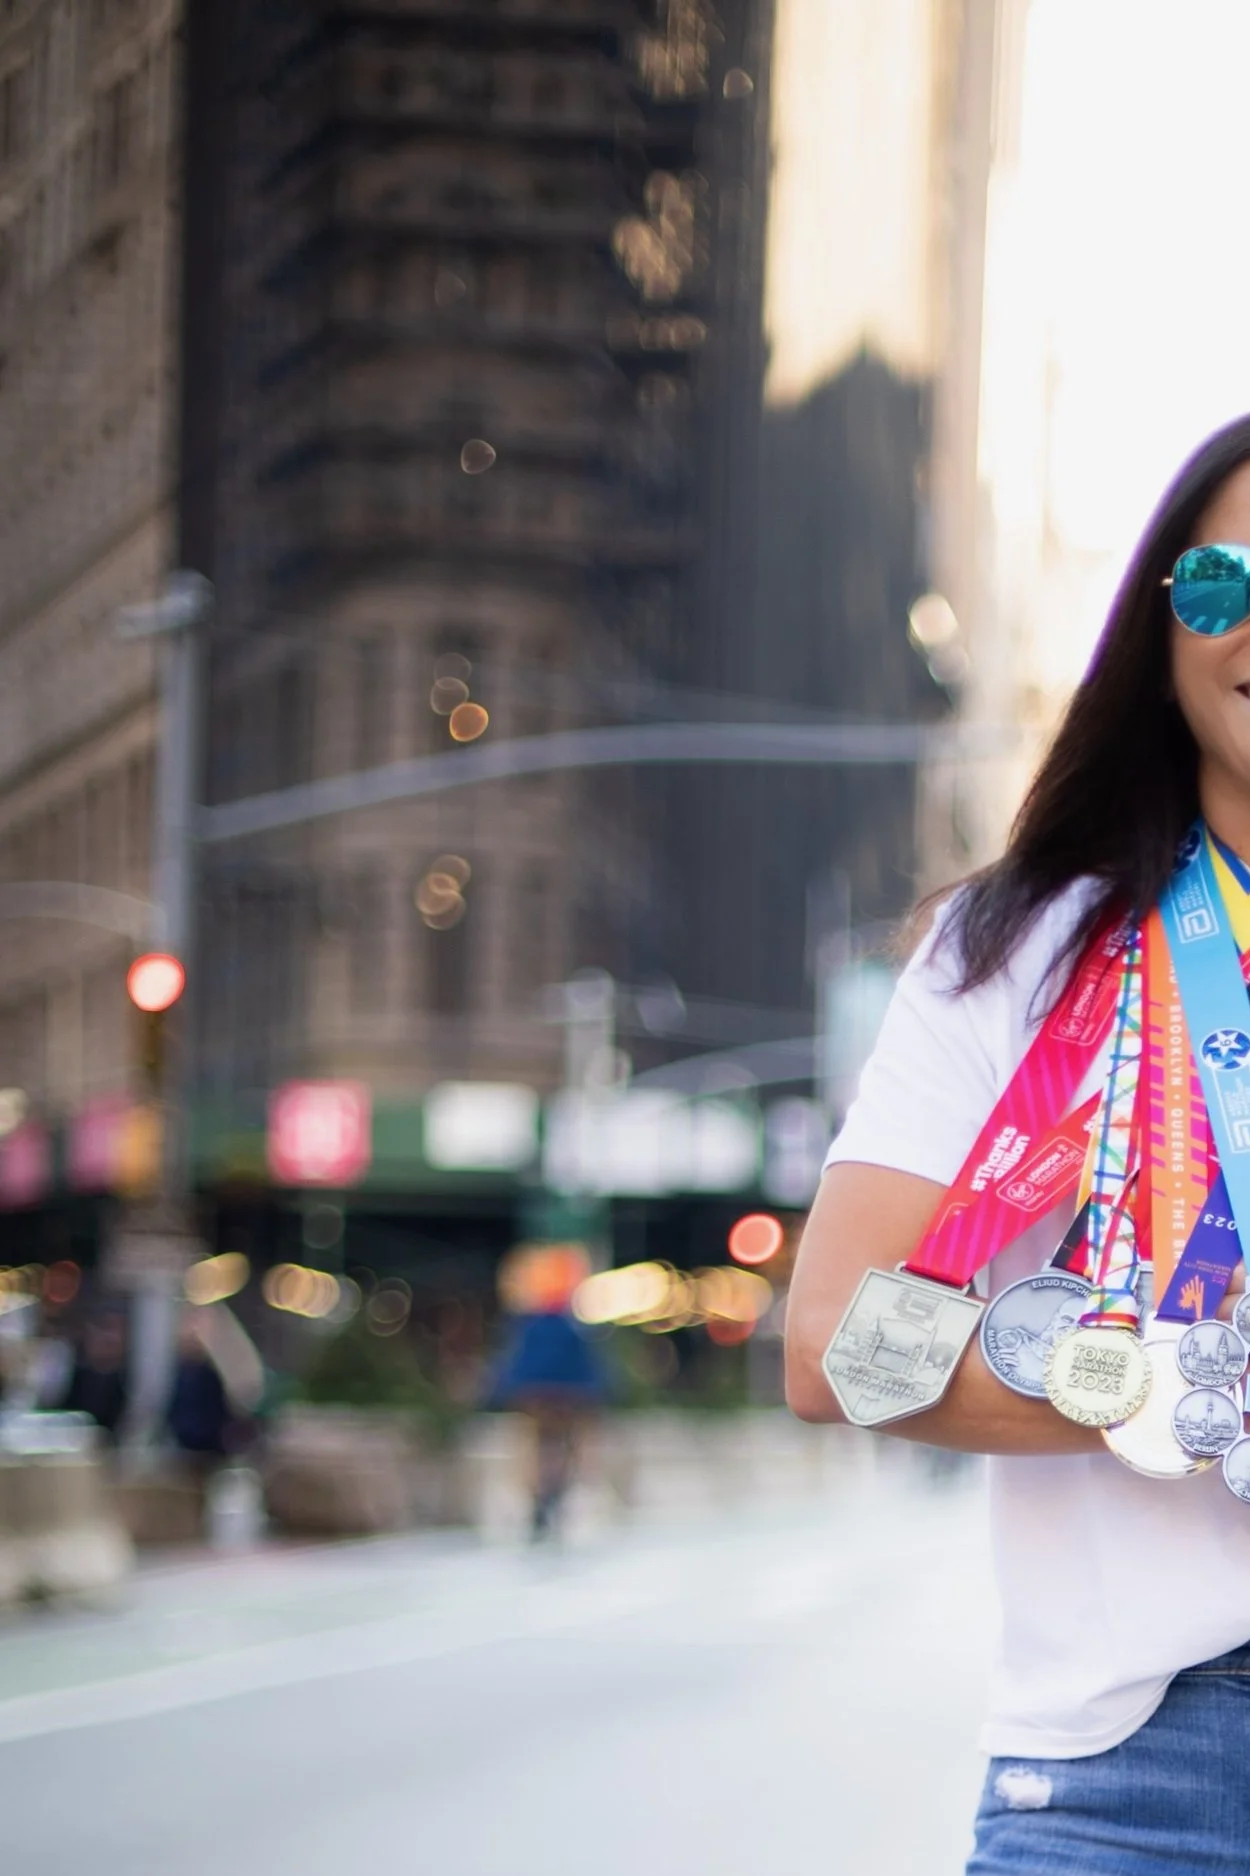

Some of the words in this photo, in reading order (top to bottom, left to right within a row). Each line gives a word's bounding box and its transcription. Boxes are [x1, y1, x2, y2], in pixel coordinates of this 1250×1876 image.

[1169, 1004, 1183, 1086] BROOKLYN
[1171, 1108, 1184, 1173] QUEENS
[970, 1125, 1018, 1192] #Thanks
[1026, 1152, 1062, 1183] LONDON
[1172, 1198, 1185, 1230] THE
[1203, 1213, 1238, 1231] 023
[1031, 1279, 1061, 1289] ELIUD
[987, 1329, 1009, 1374] MARATHON
[1071, 1358, 1126, 1376] MARATHON
[1074, 1344, 1130, 1366] TOKYO
[1067, 1370, 1125, 1394] 2023
